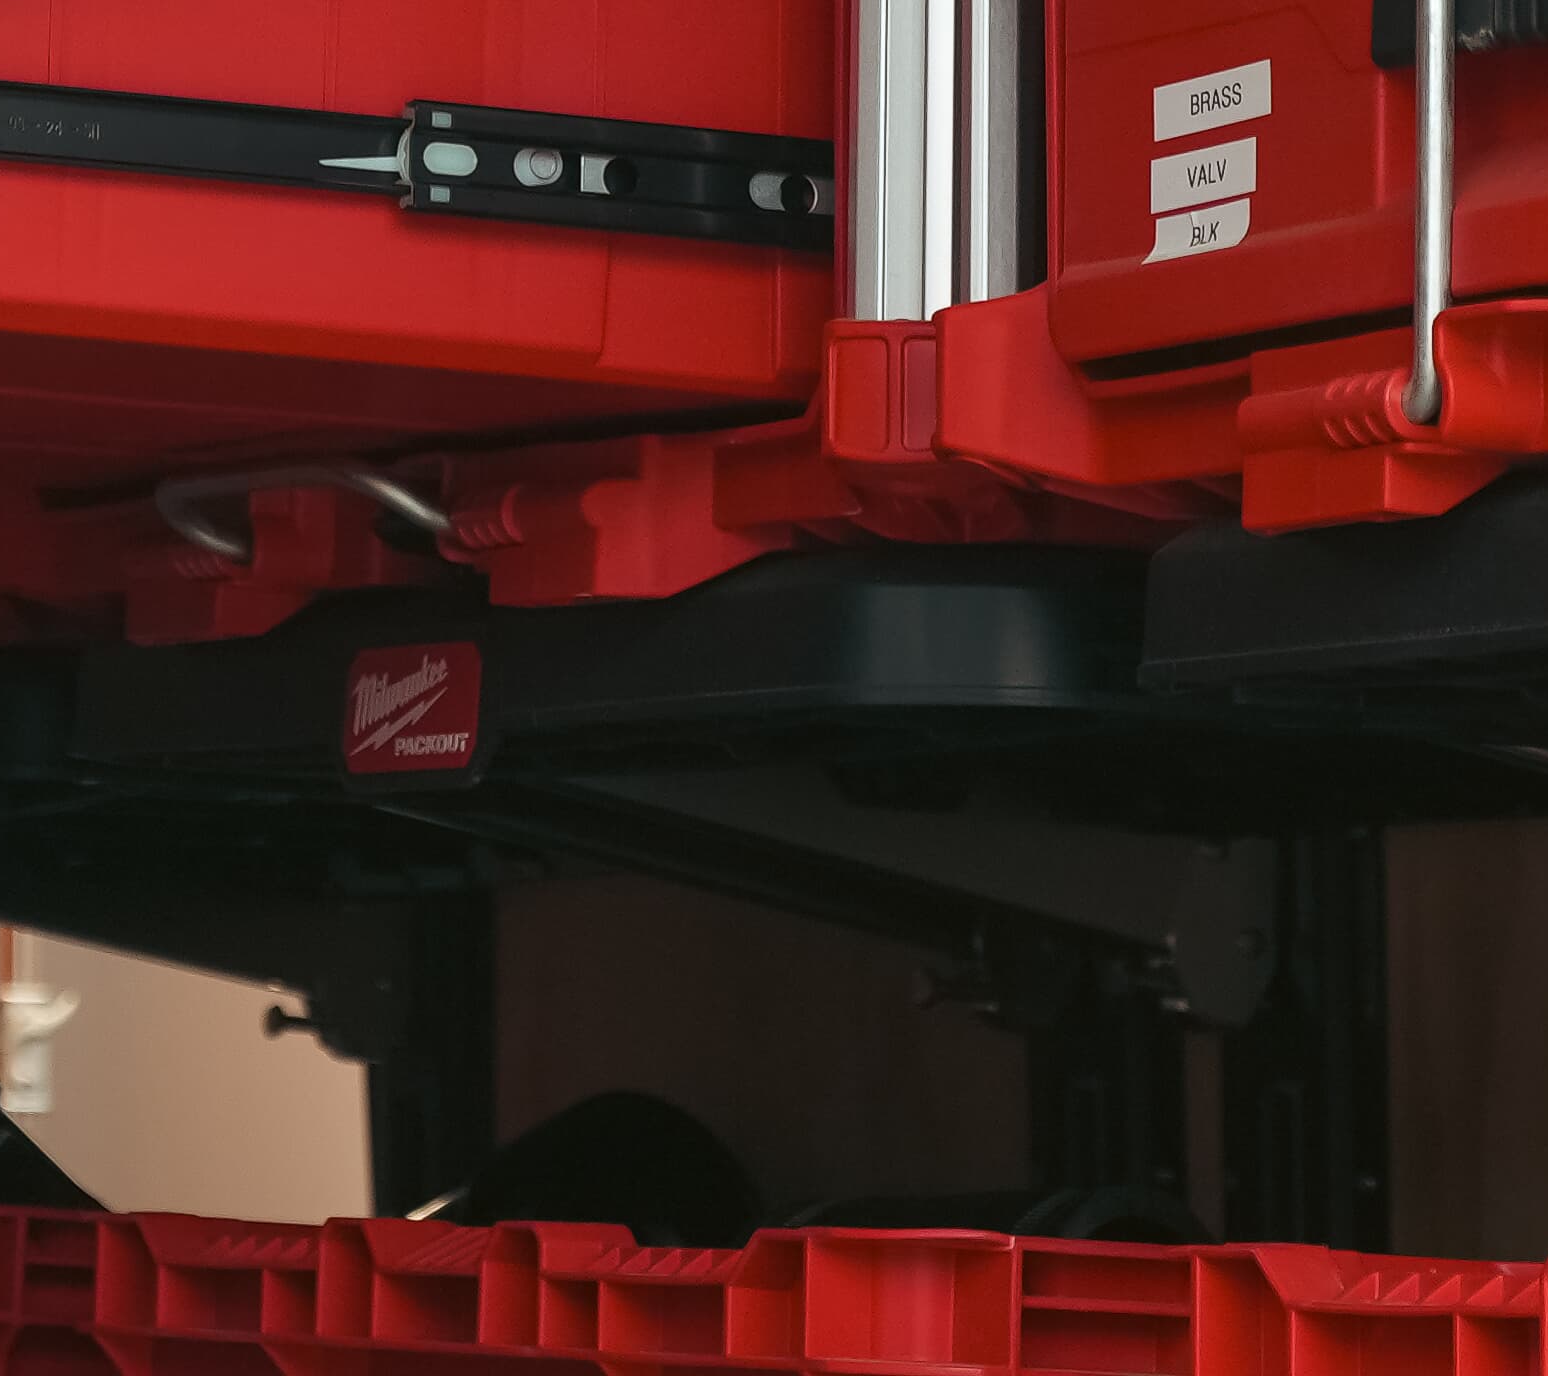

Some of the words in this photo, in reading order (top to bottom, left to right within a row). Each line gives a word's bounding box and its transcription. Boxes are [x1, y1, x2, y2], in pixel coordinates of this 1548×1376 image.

[1189, 81, 1243, 117] BRASS
[1186, 158, 1228, 189] VALV
[1188, 220, 1221, 249] BLK
[393, 732, 471, 757] PACKOUT
